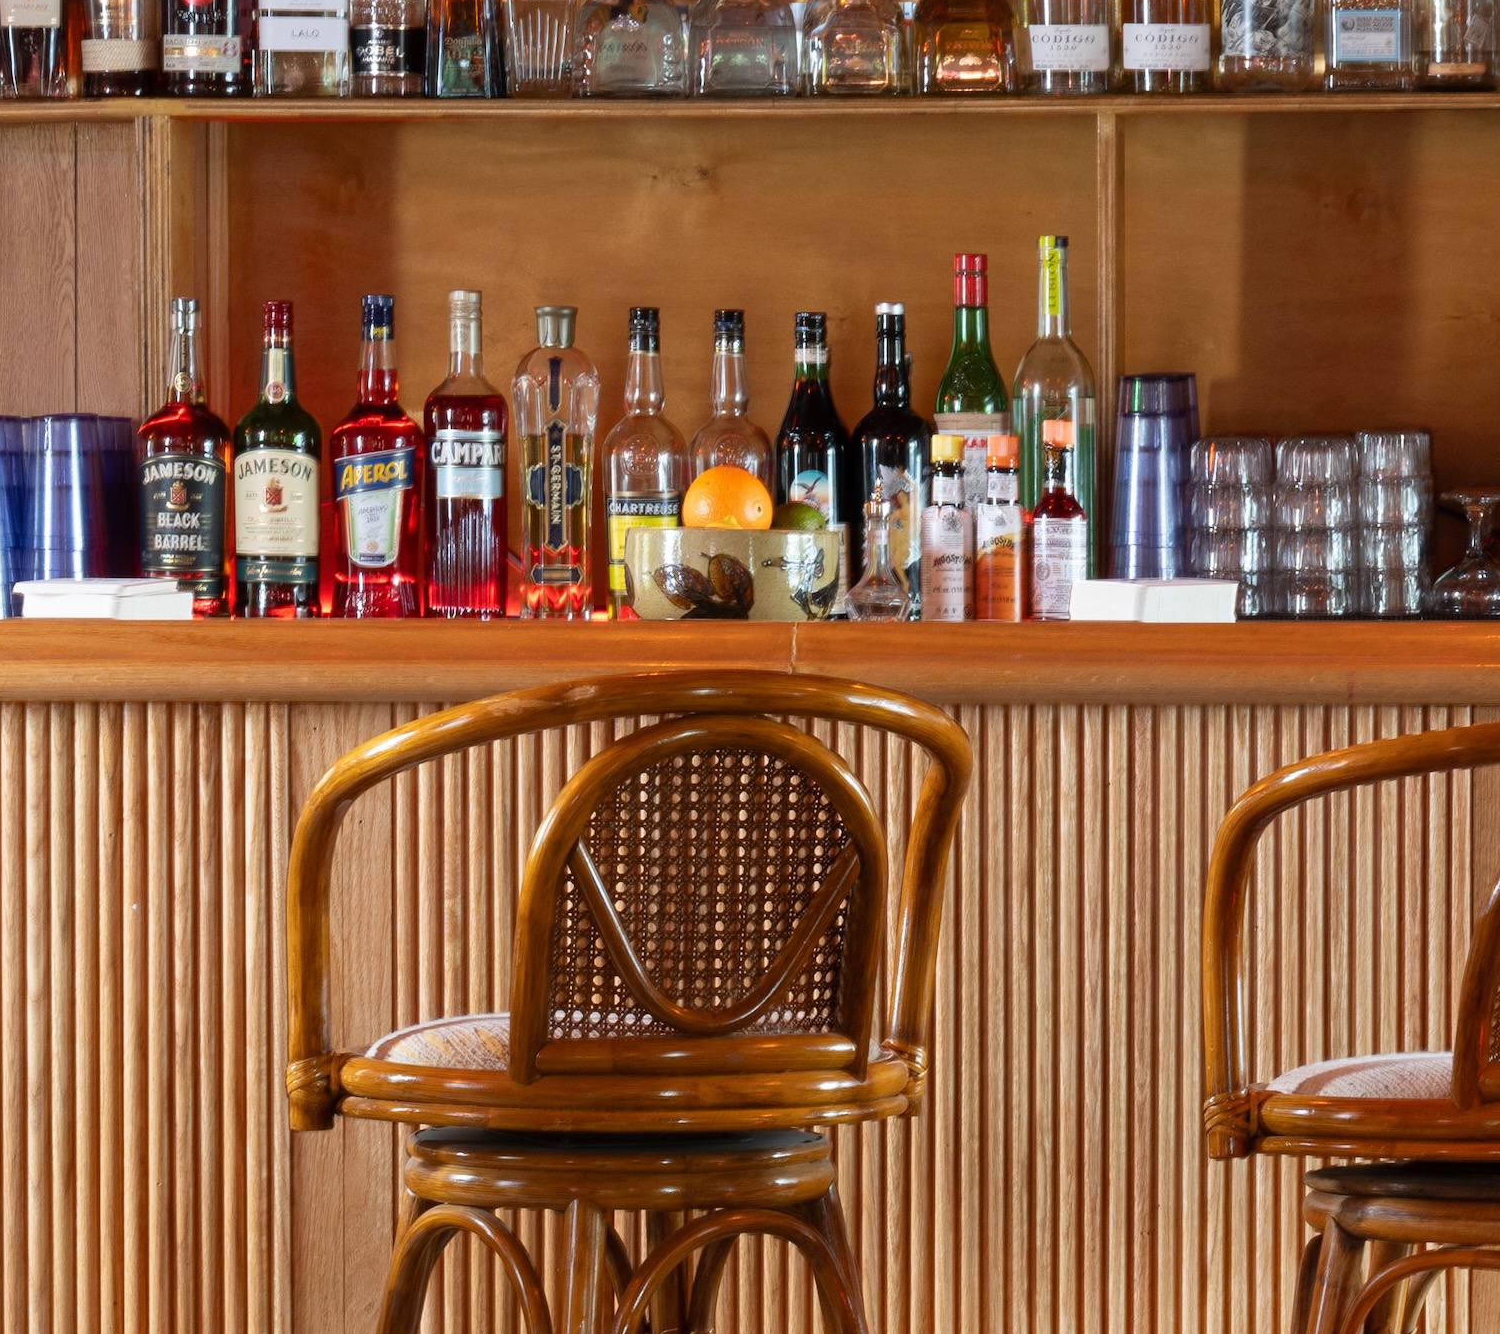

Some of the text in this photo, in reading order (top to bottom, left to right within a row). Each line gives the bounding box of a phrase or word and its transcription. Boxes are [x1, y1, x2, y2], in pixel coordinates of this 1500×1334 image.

[290, 29, 320, 39] LALO
[1031, 32, 1096, 45] CÓDIGO
[1135, 32, 1199, 45] CÓDIGO
[356, 45, 404, 59] DOBEL
[142, 461, 219, 486] JAMESON
[238, 458, 314, 482] JAMESON
[340, 458, 411, 492] APEROL
[608, 501, 679, 517] CHARTREUSE
[156, 511, 200, 530] BLACK
[154, 534, 206, 552] BARREL
